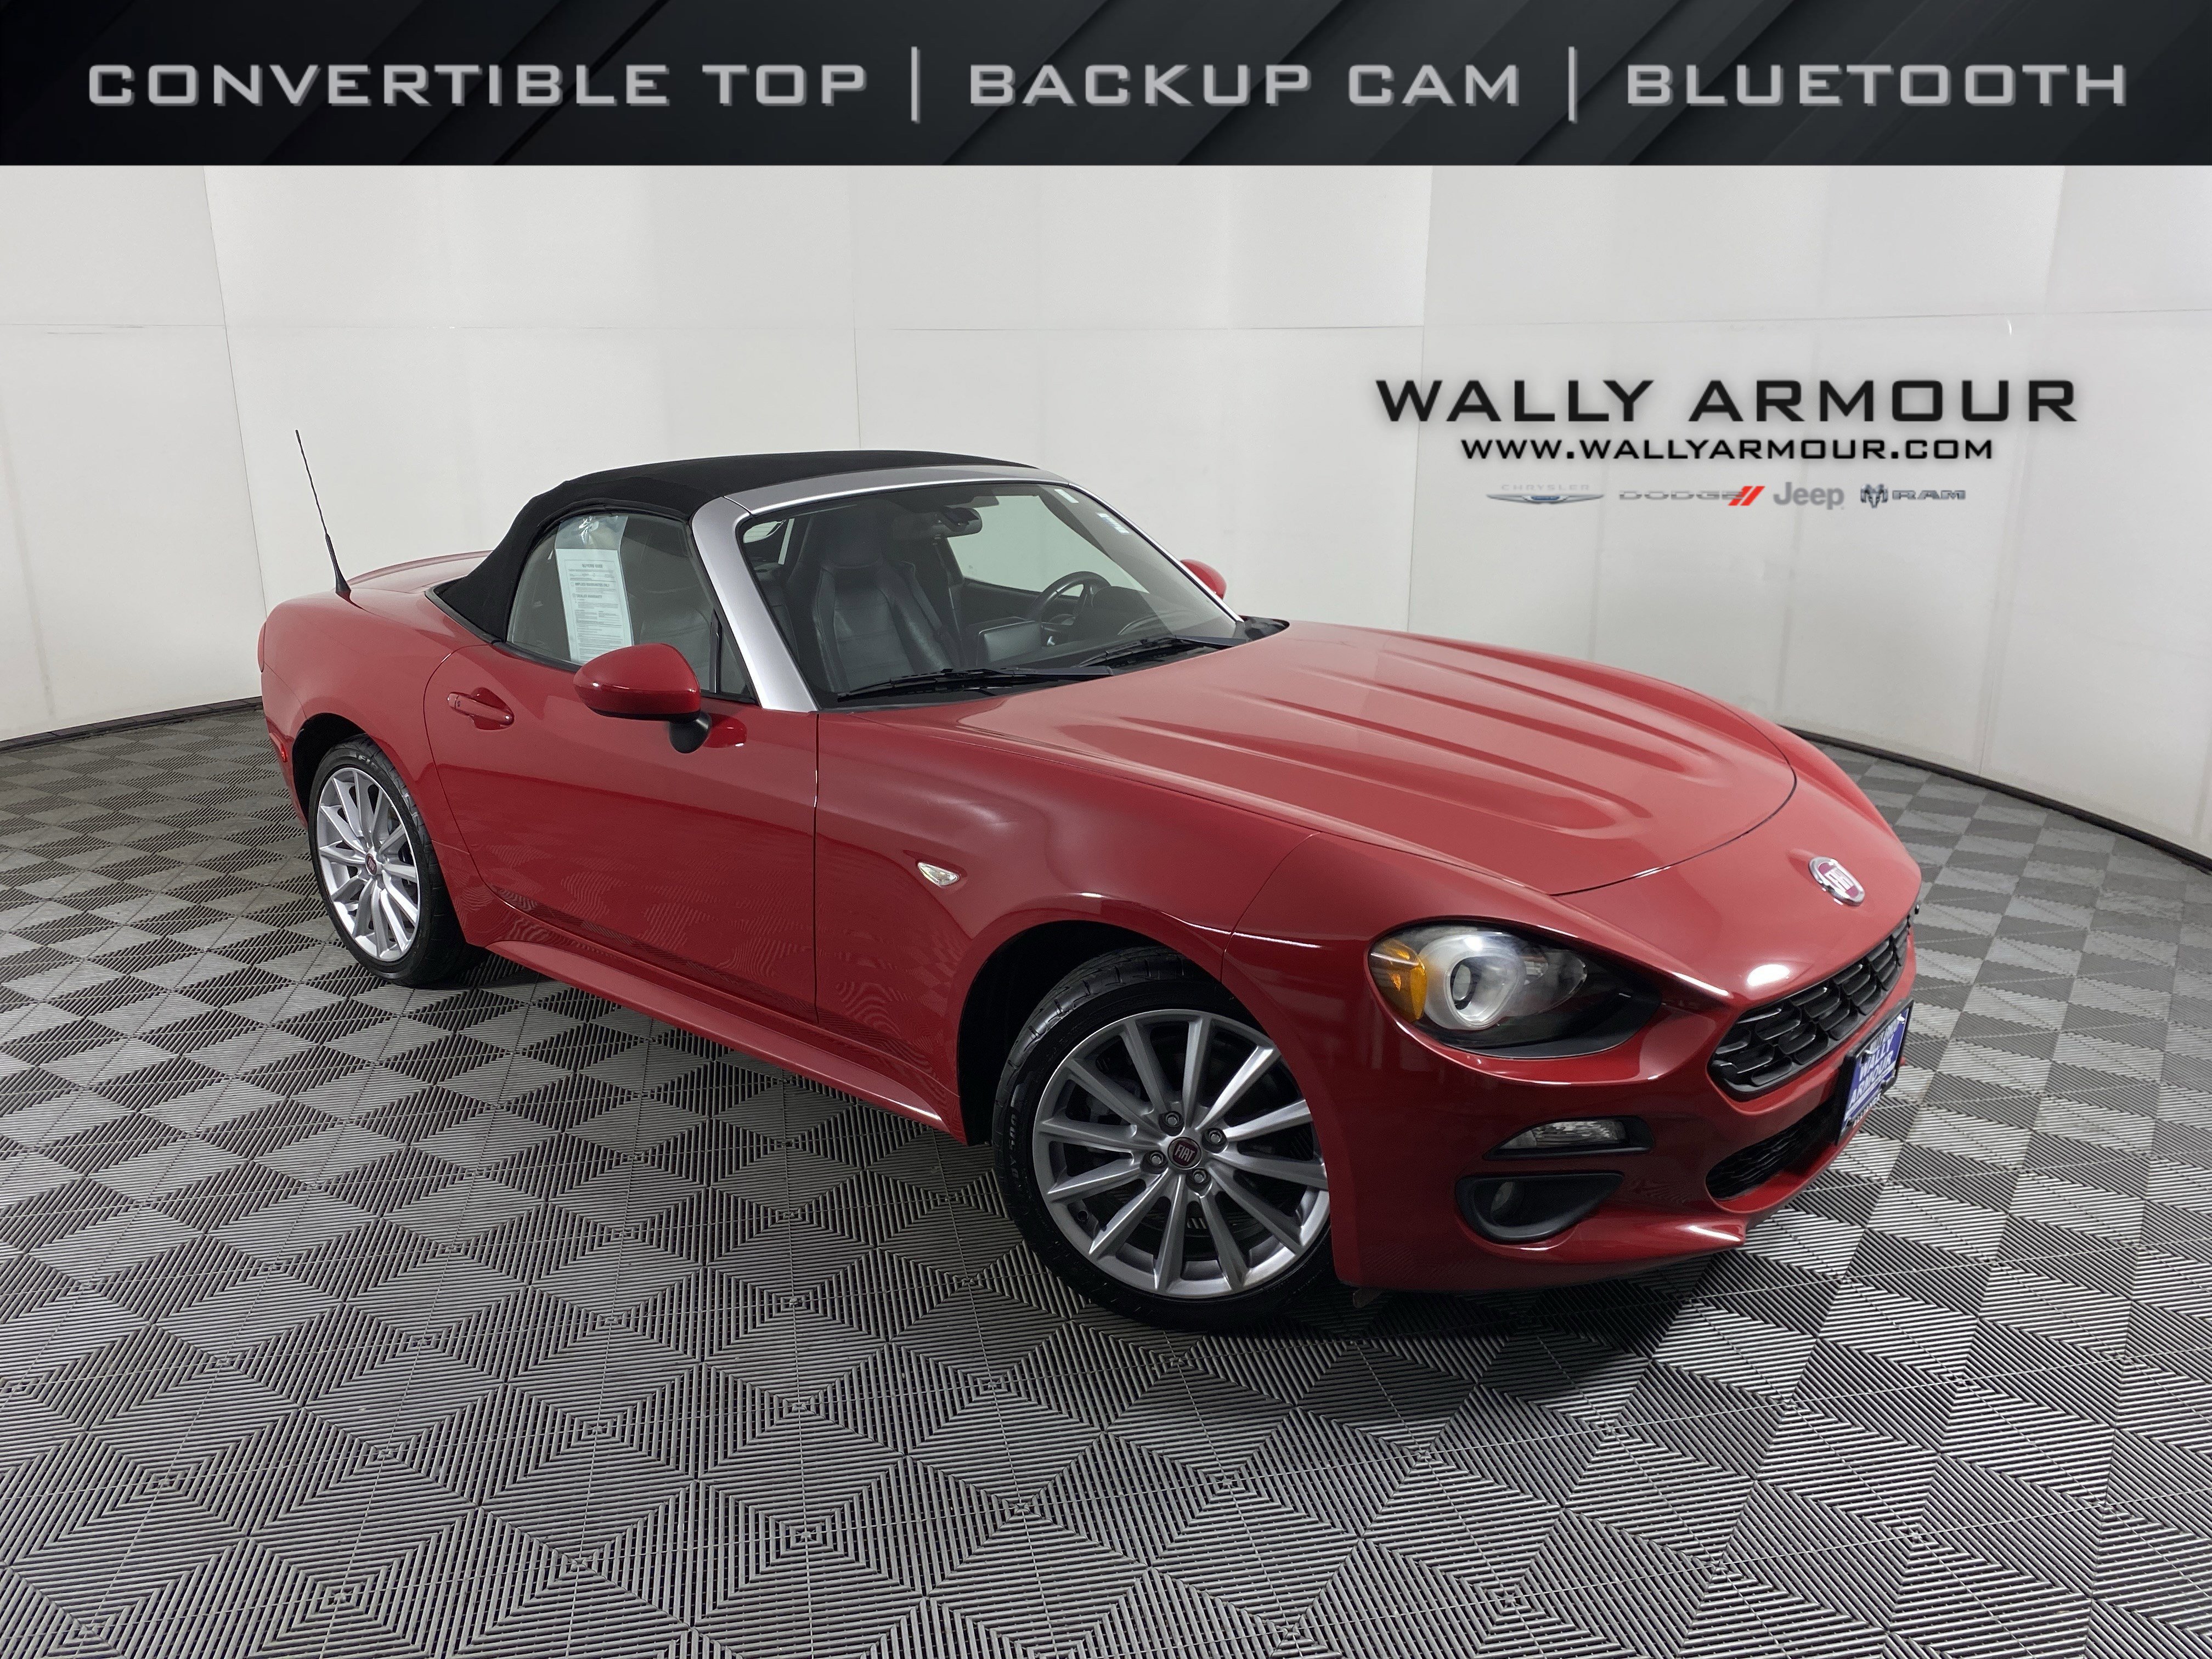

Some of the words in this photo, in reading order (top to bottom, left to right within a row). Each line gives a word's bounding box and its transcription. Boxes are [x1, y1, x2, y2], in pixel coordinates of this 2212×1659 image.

[1848, 1050, 1894, 1108] ARMOUR
[1860, 1034, 1894, 1082] WALLY
[1175, 1144, 1195, 1163] FIAT
